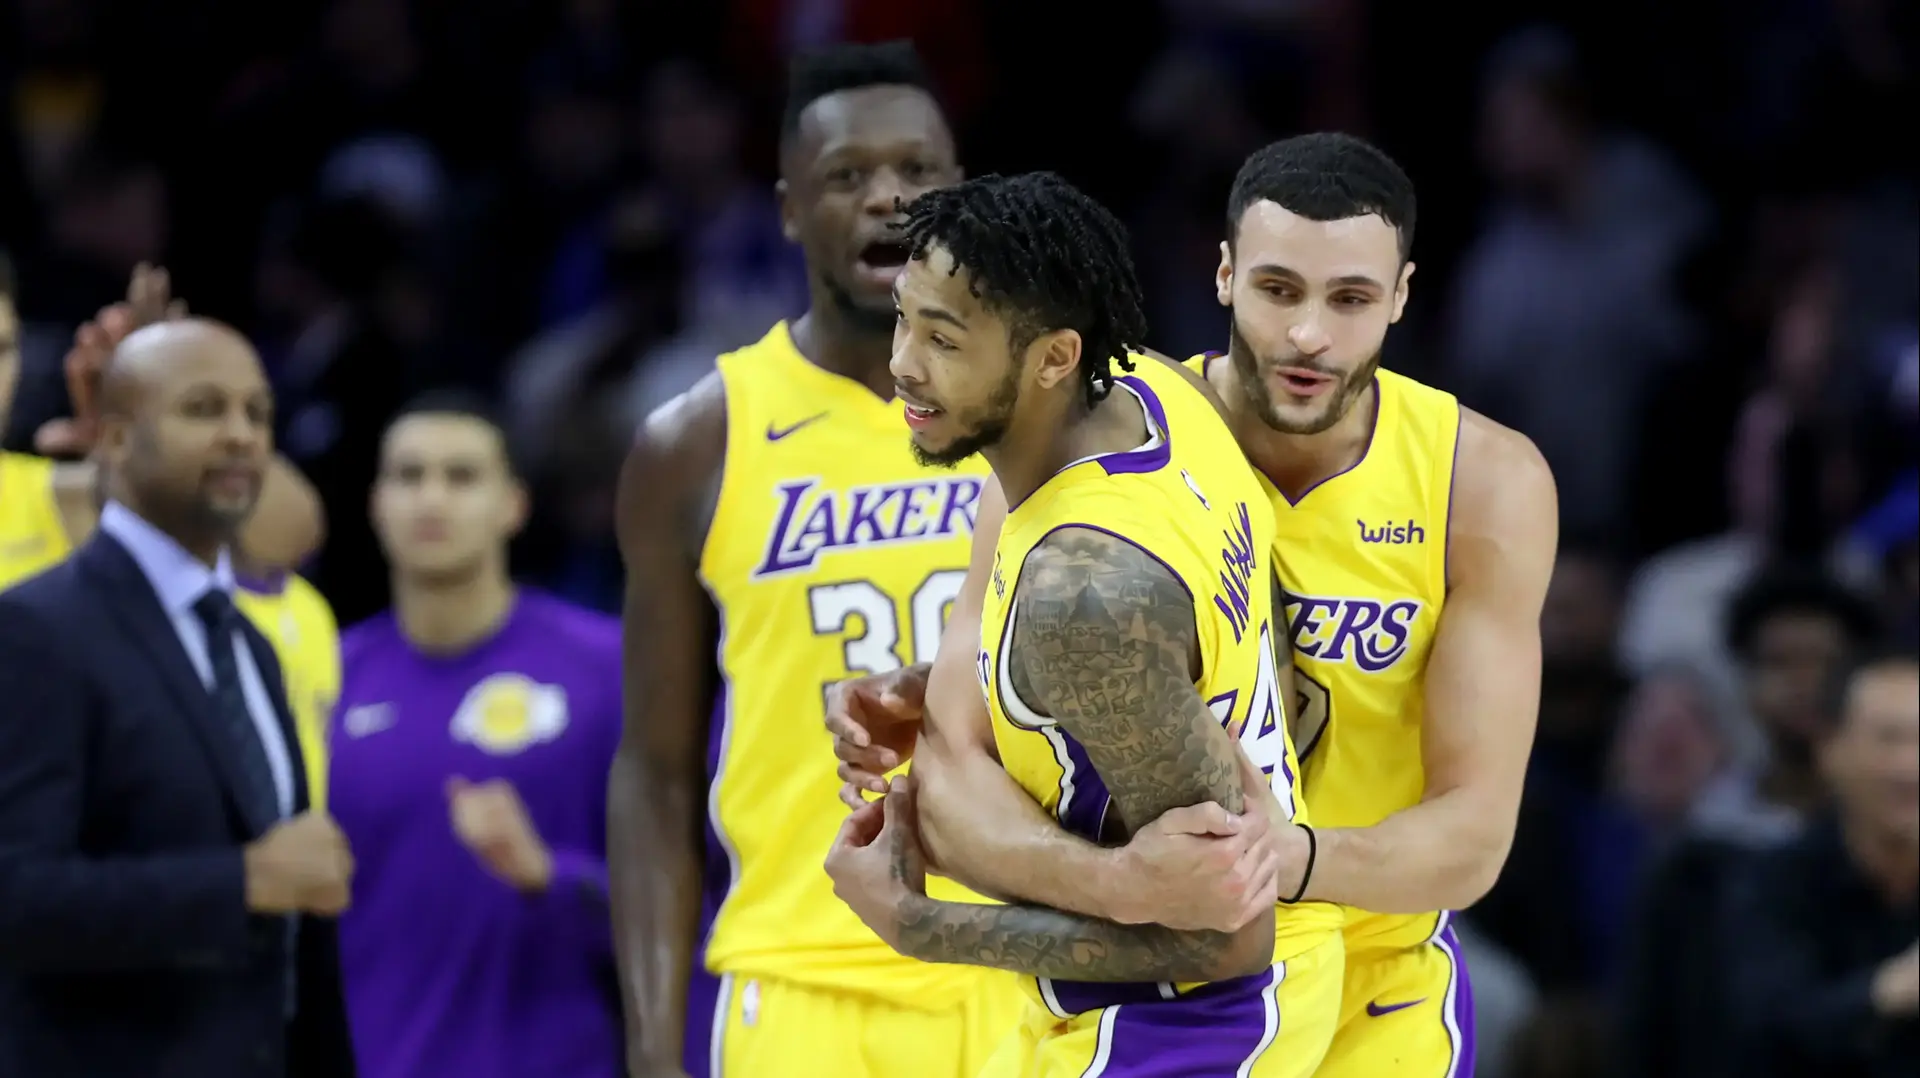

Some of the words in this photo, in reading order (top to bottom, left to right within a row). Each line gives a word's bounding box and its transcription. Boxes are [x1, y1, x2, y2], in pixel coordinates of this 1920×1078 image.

[751, 476, 983, 579] LAKER
[1357, 518, 1425, 545] wish
[1284, 592, 1420, 673] ERS
